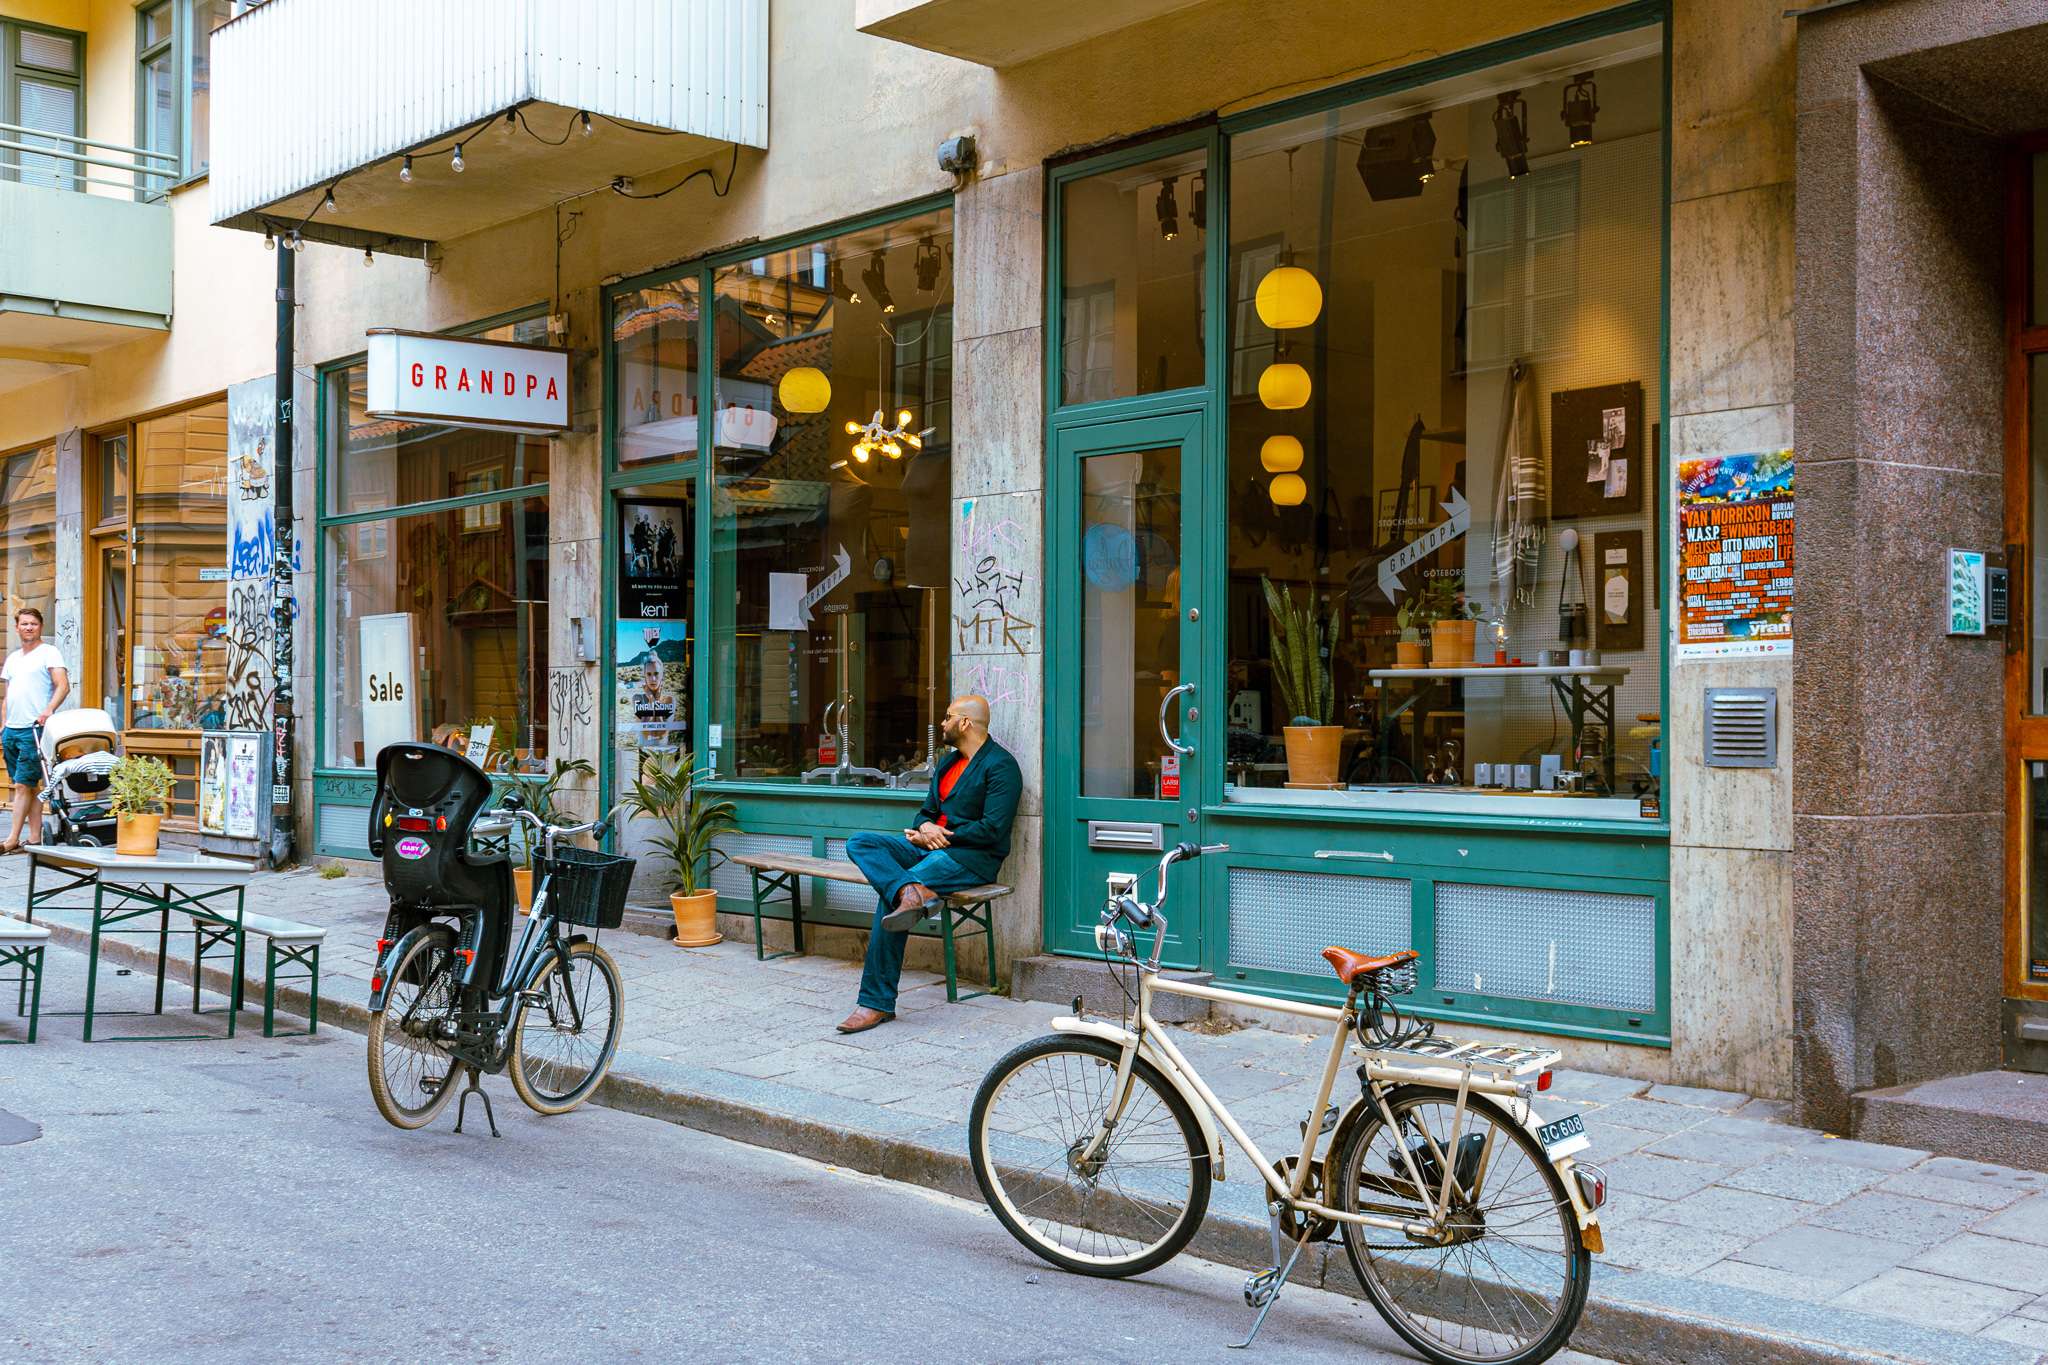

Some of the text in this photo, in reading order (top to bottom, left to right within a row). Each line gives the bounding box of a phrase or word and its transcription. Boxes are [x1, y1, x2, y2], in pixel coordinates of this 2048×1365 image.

[411, 362, 559, 401] GRANDPA
[1686, 504, 1770, 528] VAN MORRISON
[1390, 520, 1456, 572] GRANDPA
[1686, 541, 1720, 555] MELISSA
[1722, 536, 1774, 552] OTTO KNOWS
[1687, 554, 1708, 567] HORN
[1709, 551, 1741, 566] BOB HUND
[1742, 549, 1774, 562] REFUSED
[640, 602, 669, 617] kent
[1750, 623, 1792, 636] yran
[369, 672, 404, 702] Sale
[1541, 1116, 1582, 1144] JC 608
